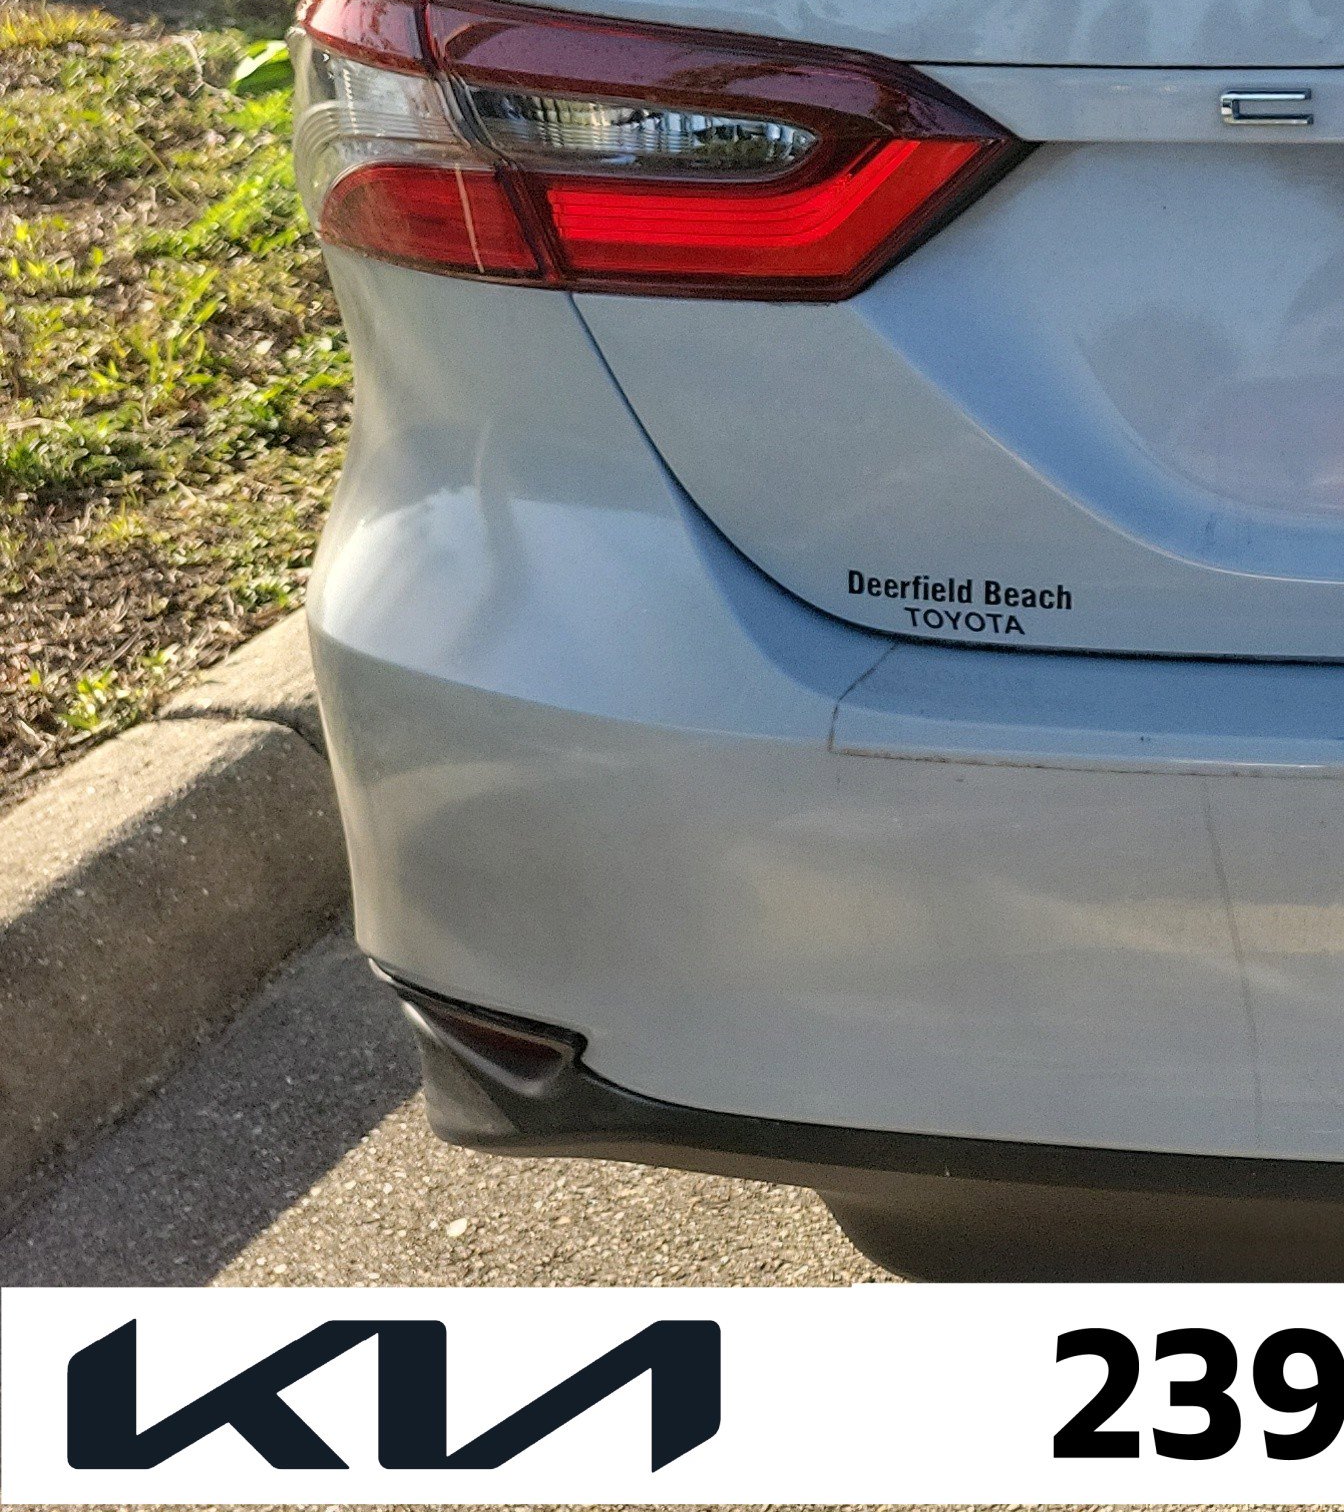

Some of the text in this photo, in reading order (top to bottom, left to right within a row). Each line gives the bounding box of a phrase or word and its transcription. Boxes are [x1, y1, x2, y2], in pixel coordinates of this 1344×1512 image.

[848, 570, 1073, 610] Deerfield Beach
[904, 606, 1026, 635] TOYOTA
